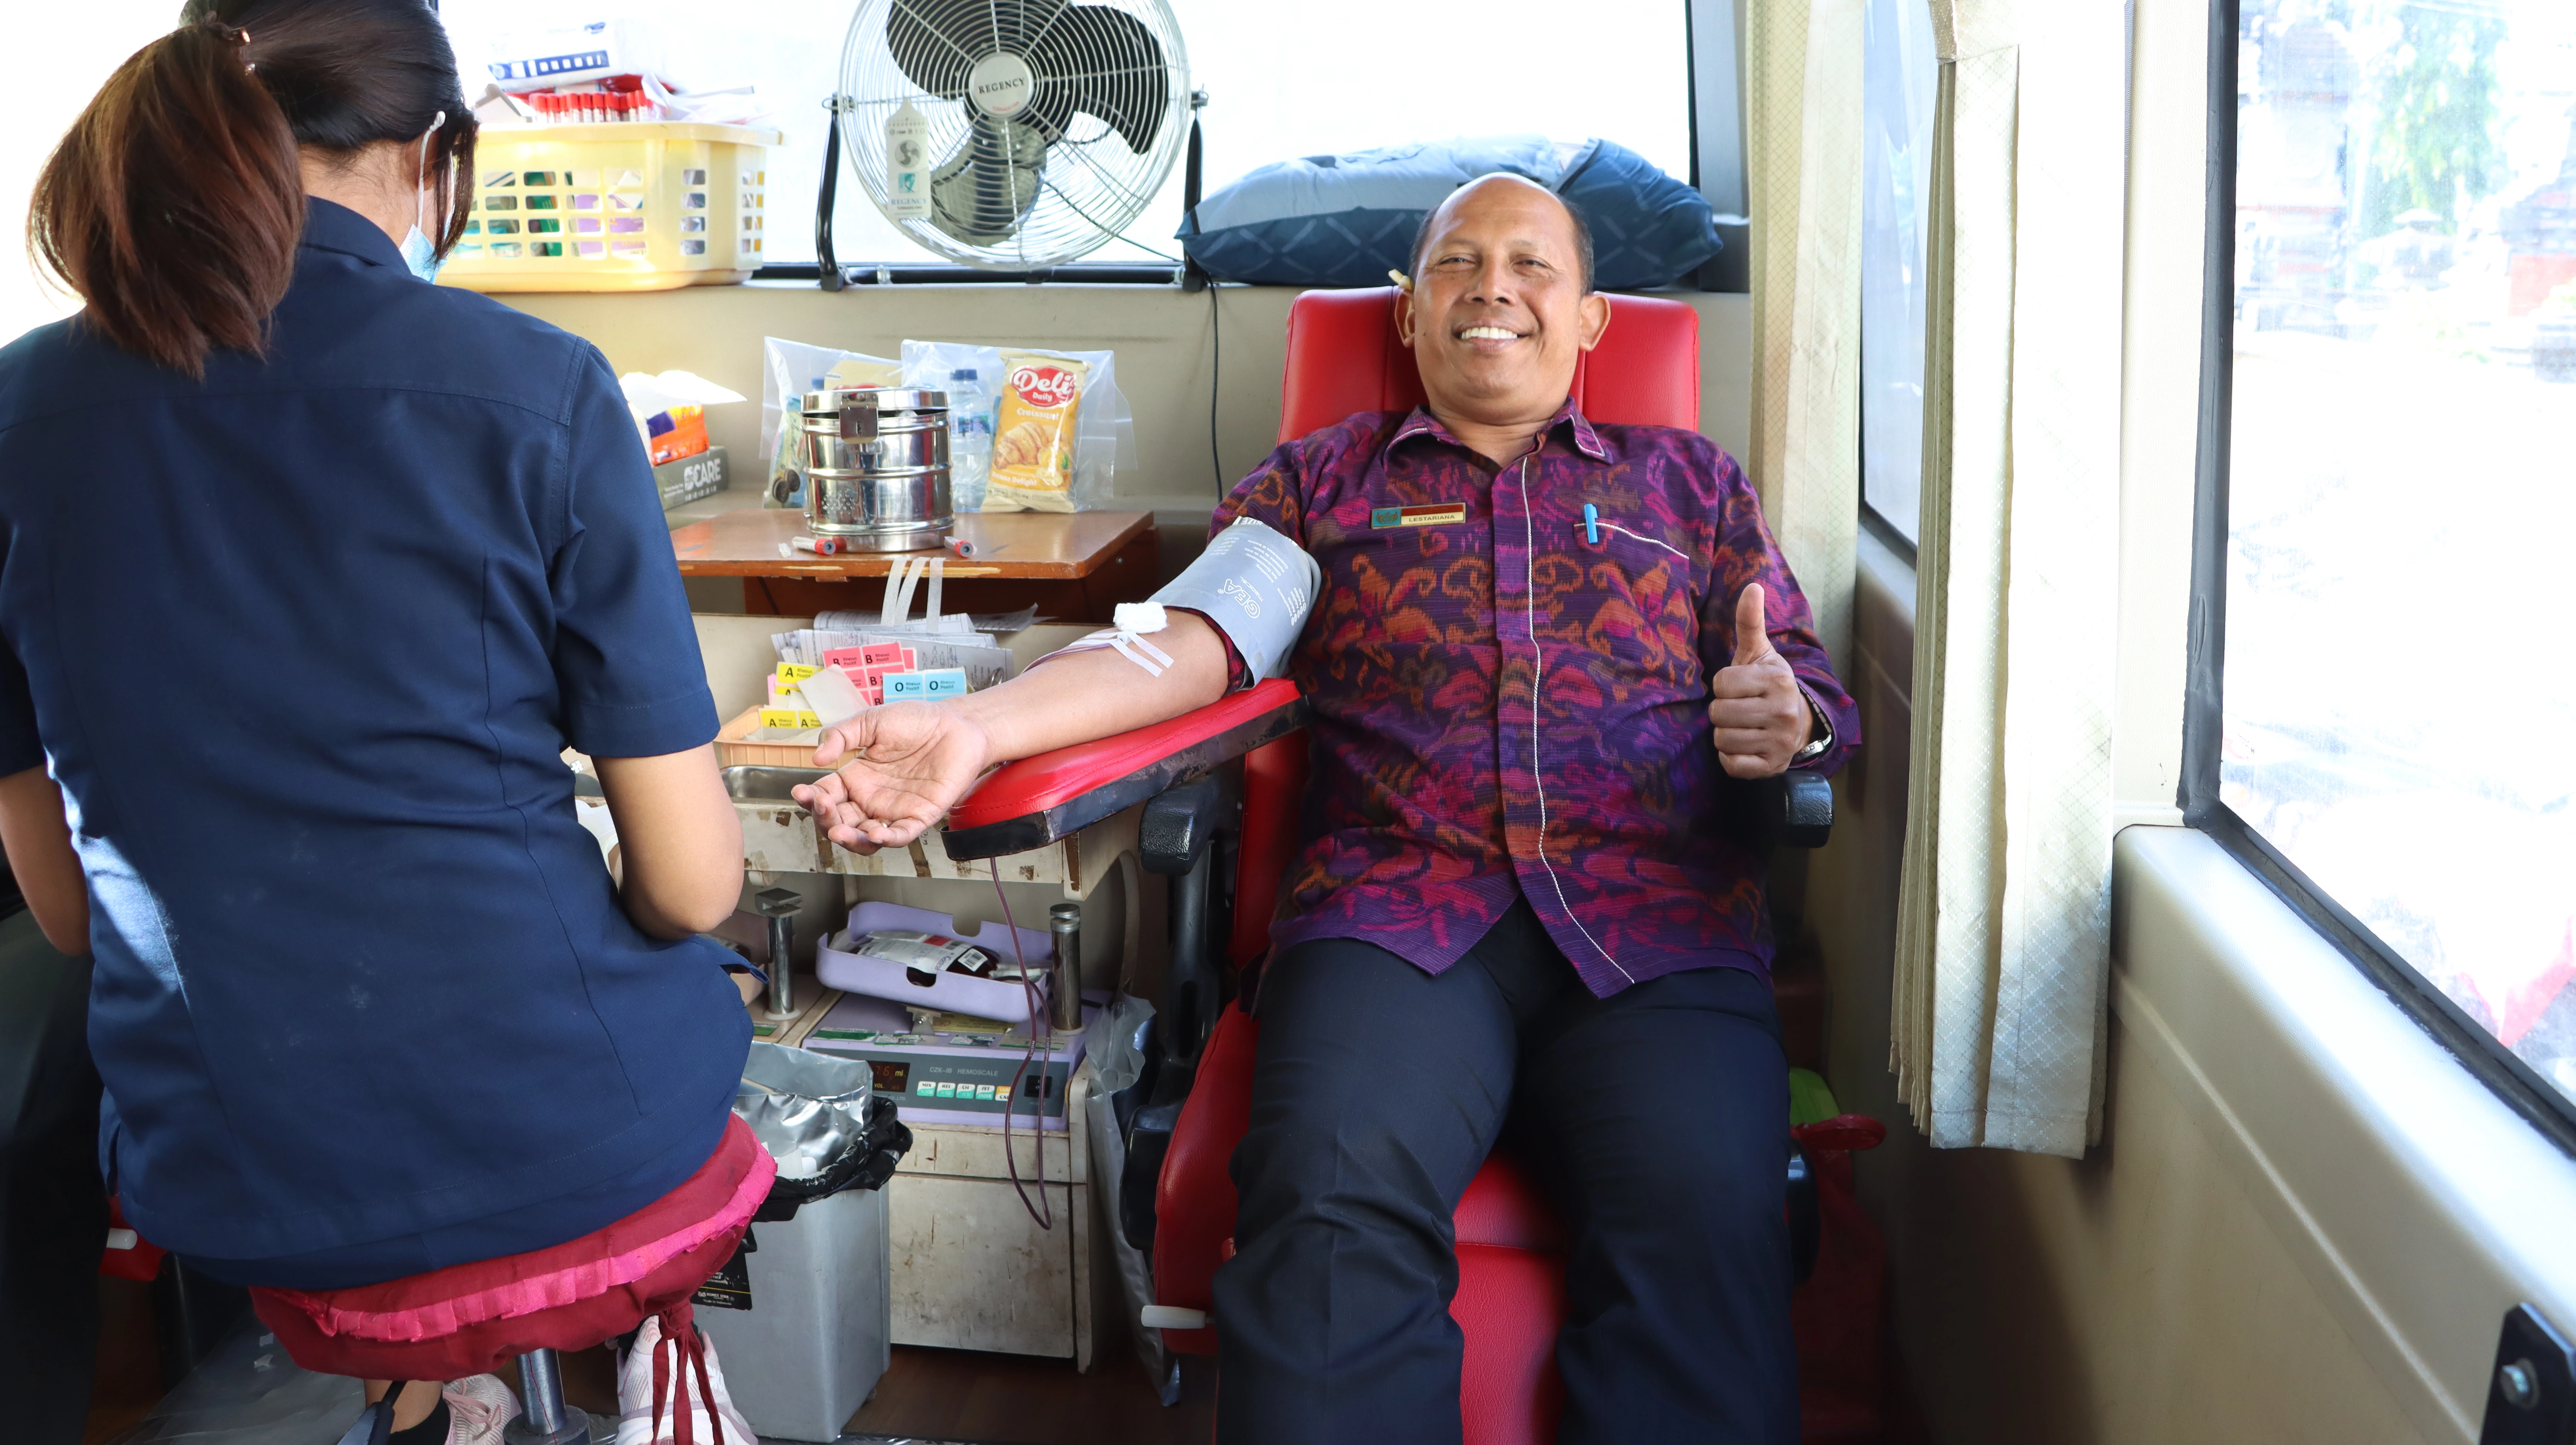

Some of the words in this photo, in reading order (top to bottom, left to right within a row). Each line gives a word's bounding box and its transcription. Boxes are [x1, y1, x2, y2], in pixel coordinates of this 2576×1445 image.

[979, 77, 1024, 94] REGENCY
[1013, 371, 1073, 395] Deli
[1032, 392, 1052, 402] Daily
[1016, 408, 1060, 420] Croissant
[1012, 476, 1037, 487] Delight
[1223, 578, 1261, 619] GEA
[1277, 587, 1293, 617] Erwachsene
[1290, 591, 1299, 609] Adultes
[1288, 597, 1296, 613] Adults
[865, 654, 873, 664] B
[785, 667, 793, 677] A
[870, 676, 877, 685] B
[929, 681, 938, 690] O
[895, 682, 903, 691] O
[769, 718, 777, 727] A
[801, 718, 809, 727] A
[957, 1067, 999, 1076] HEMOSCALE
